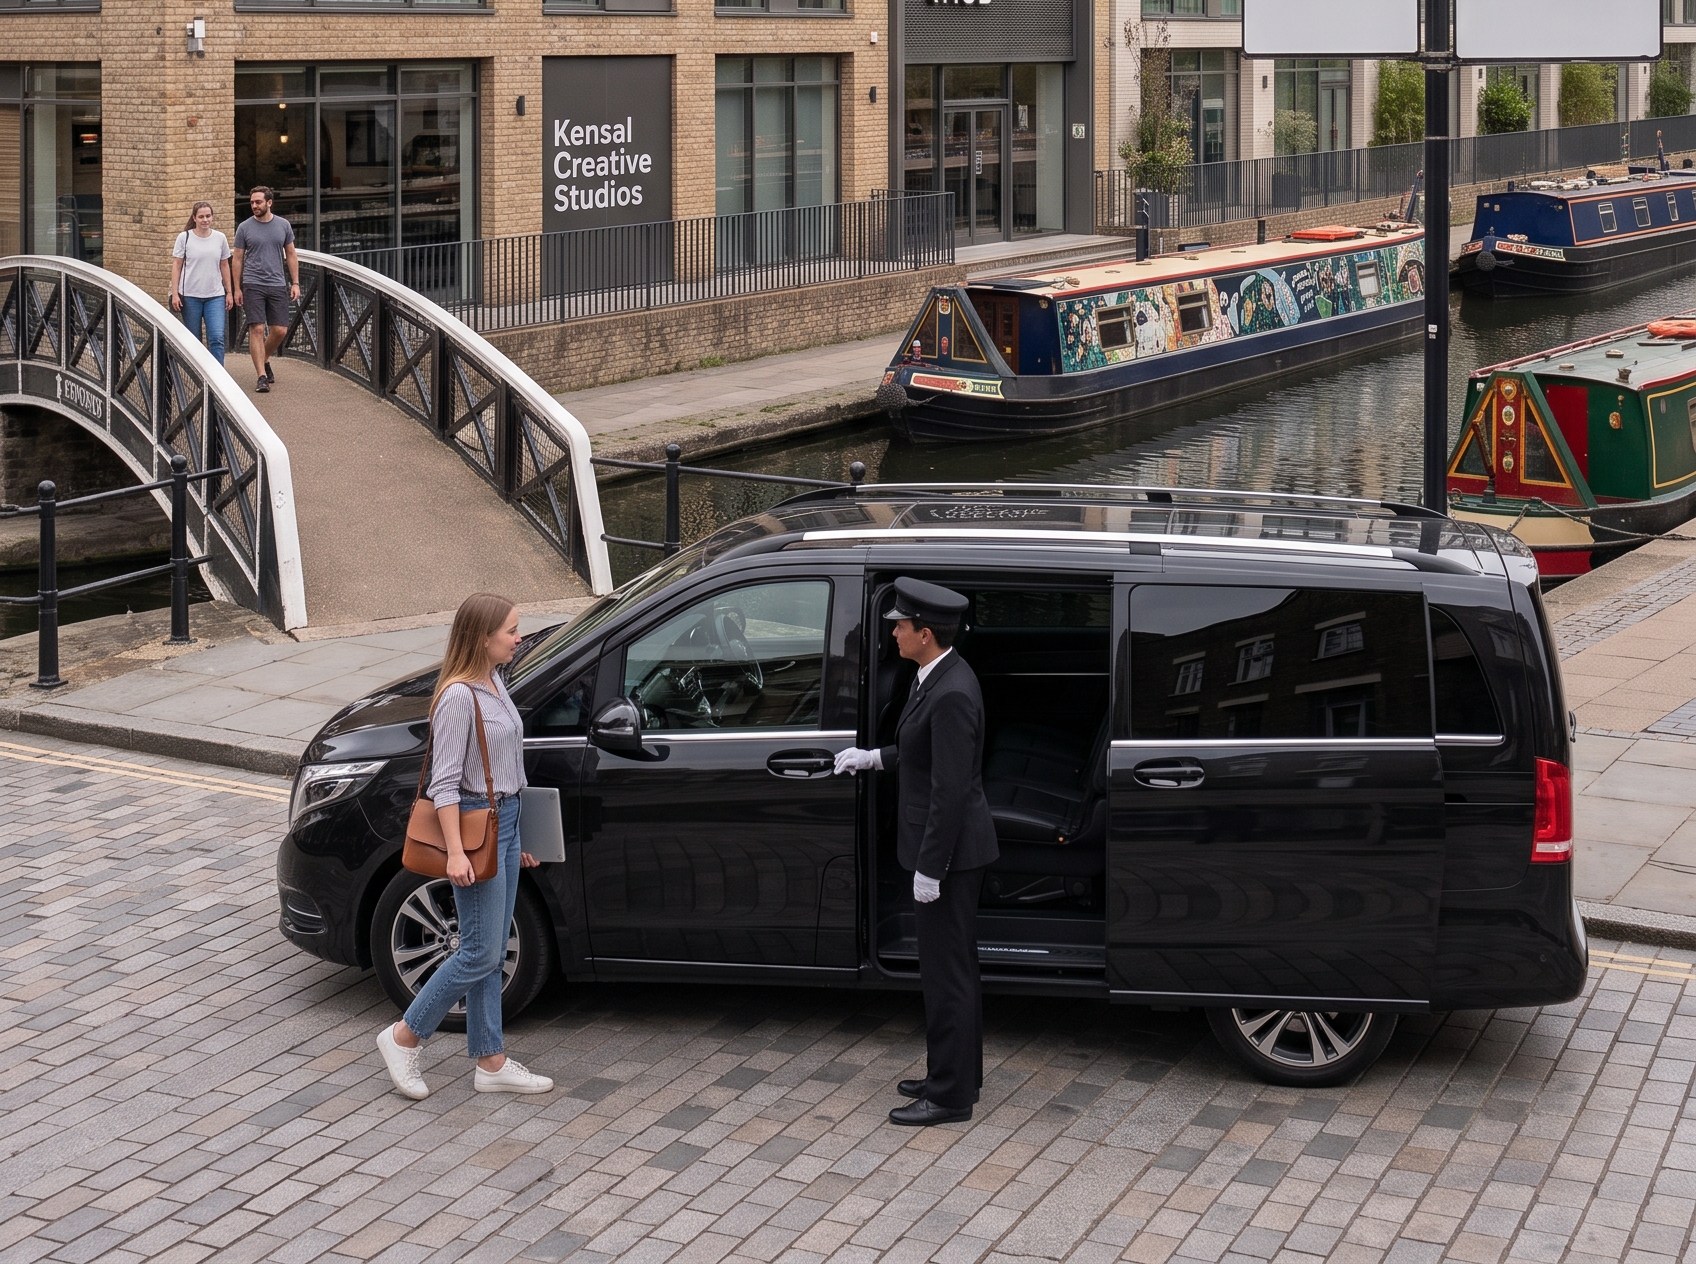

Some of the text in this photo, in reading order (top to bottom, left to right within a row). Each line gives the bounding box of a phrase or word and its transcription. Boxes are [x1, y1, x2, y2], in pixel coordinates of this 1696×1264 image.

[554, 116, 632, 147] Kensal
[553, 147, 652, 179] Creative
[554, 179, 643, 212] Studios
